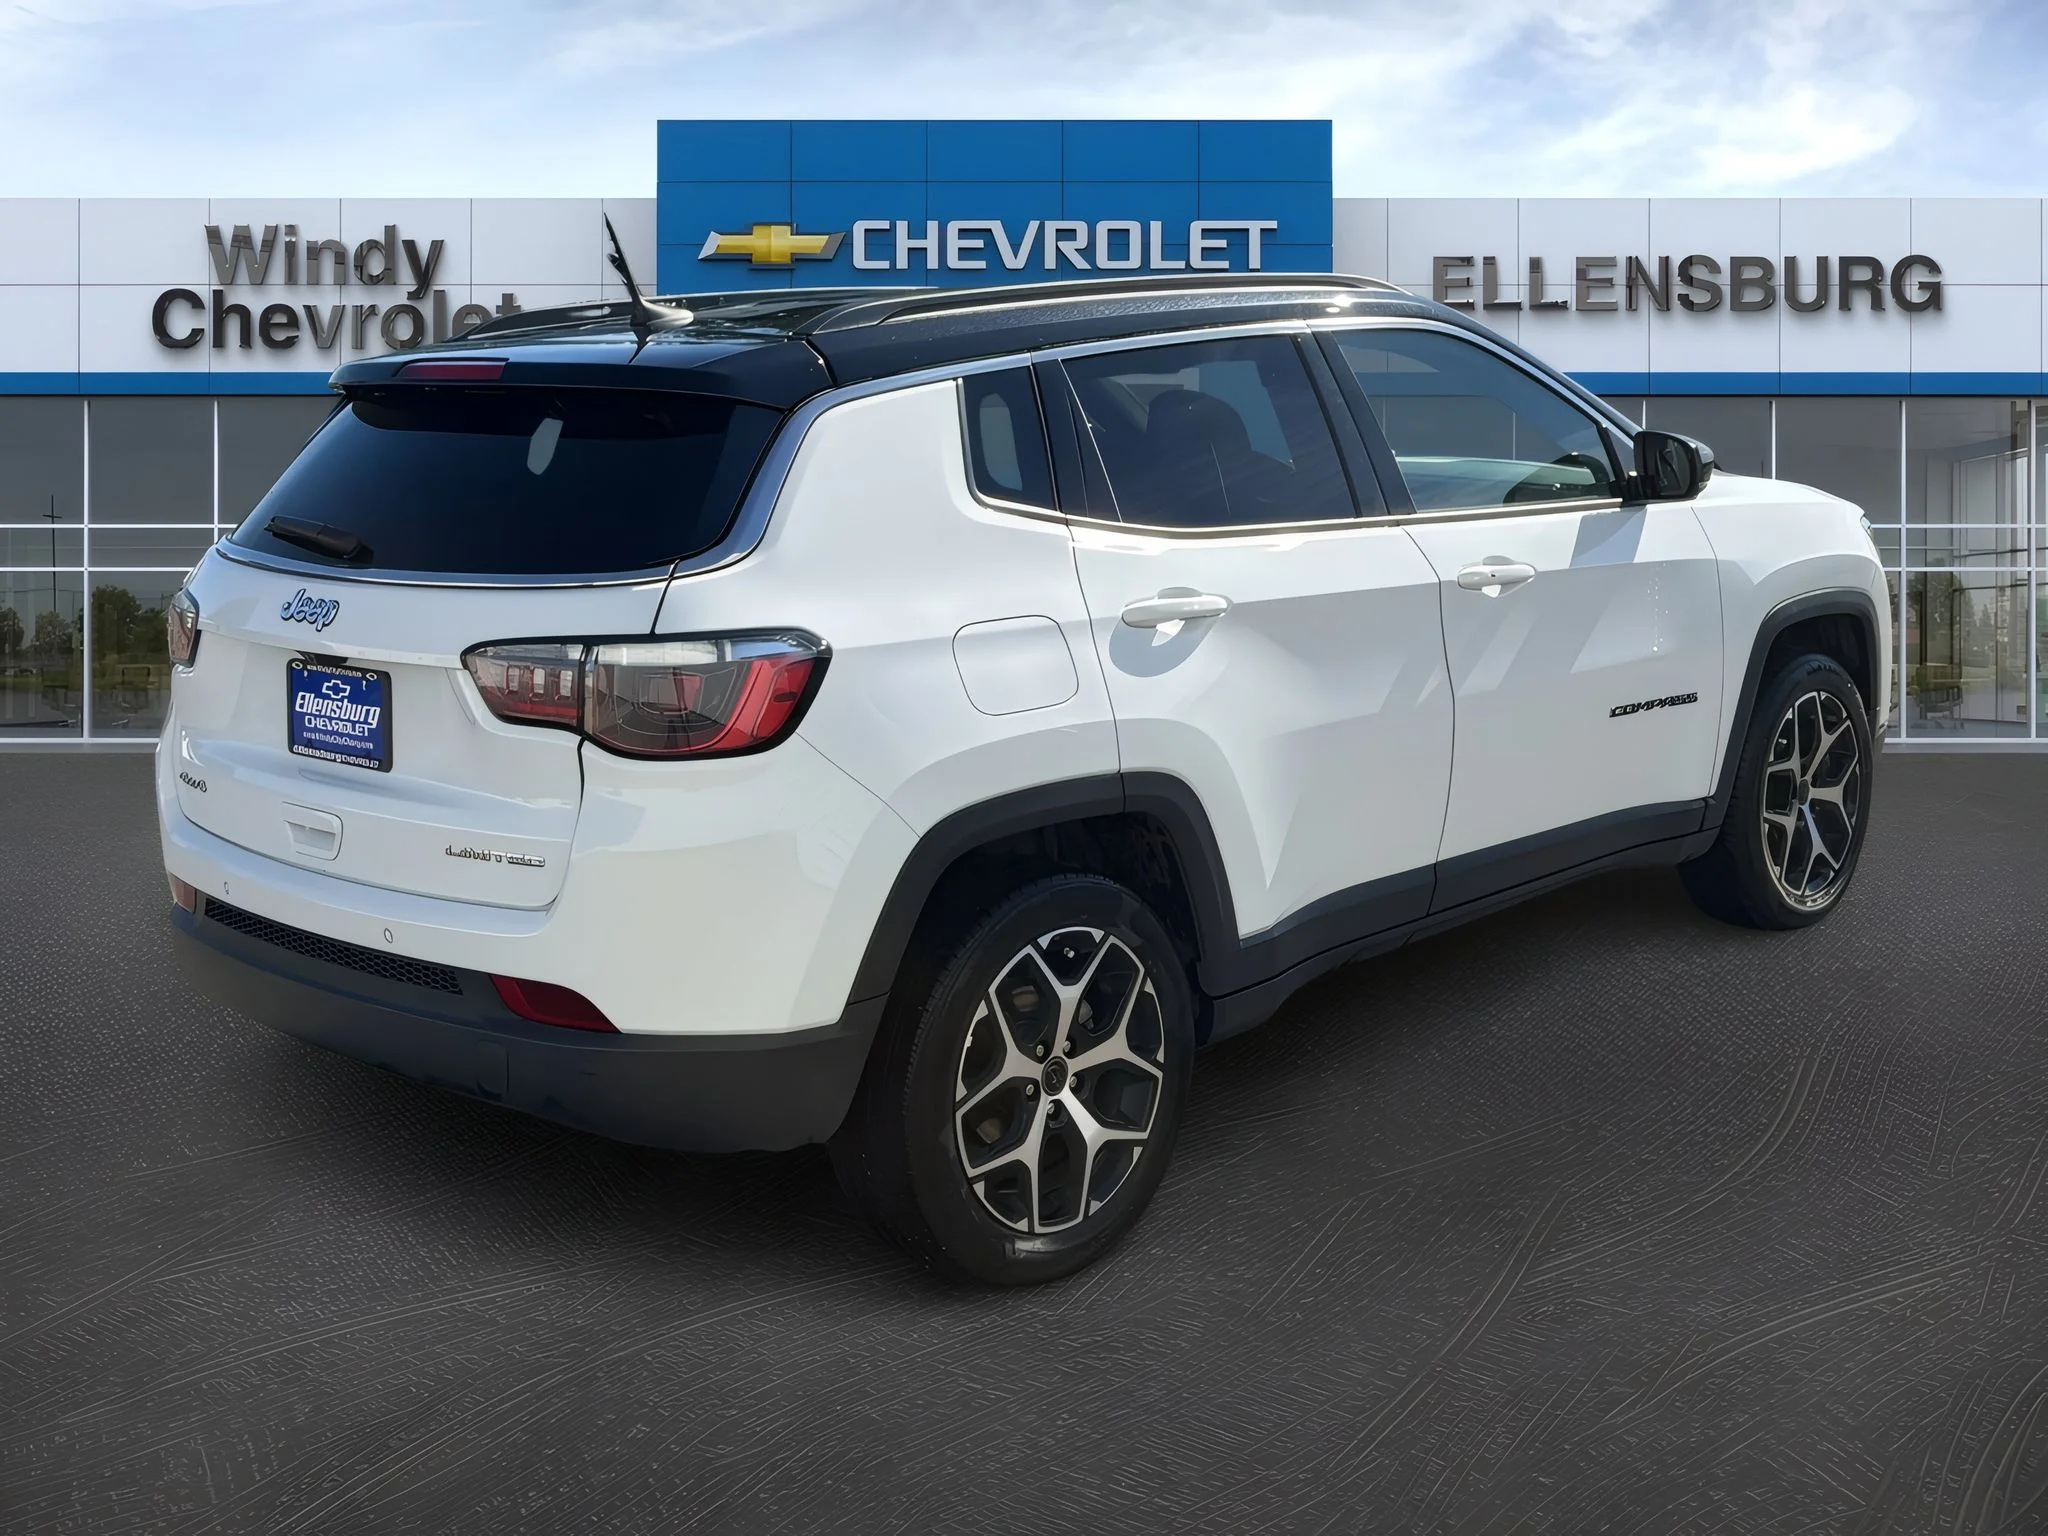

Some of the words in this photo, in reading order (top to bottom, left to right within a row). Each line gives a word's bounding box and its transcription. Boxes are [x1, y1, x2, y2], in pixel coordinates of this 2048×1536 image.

[204, 223, 444, 300] Windy
[852, 219, 1278, 271] CHEVROLET
[1432, 254, 1944, 313] ELLENSBURG
[280, 588, 340, 632] Jeep
[295, 691, 381, 729] Ellensburg
[304, 715, 369, 737] CHEVROLET
